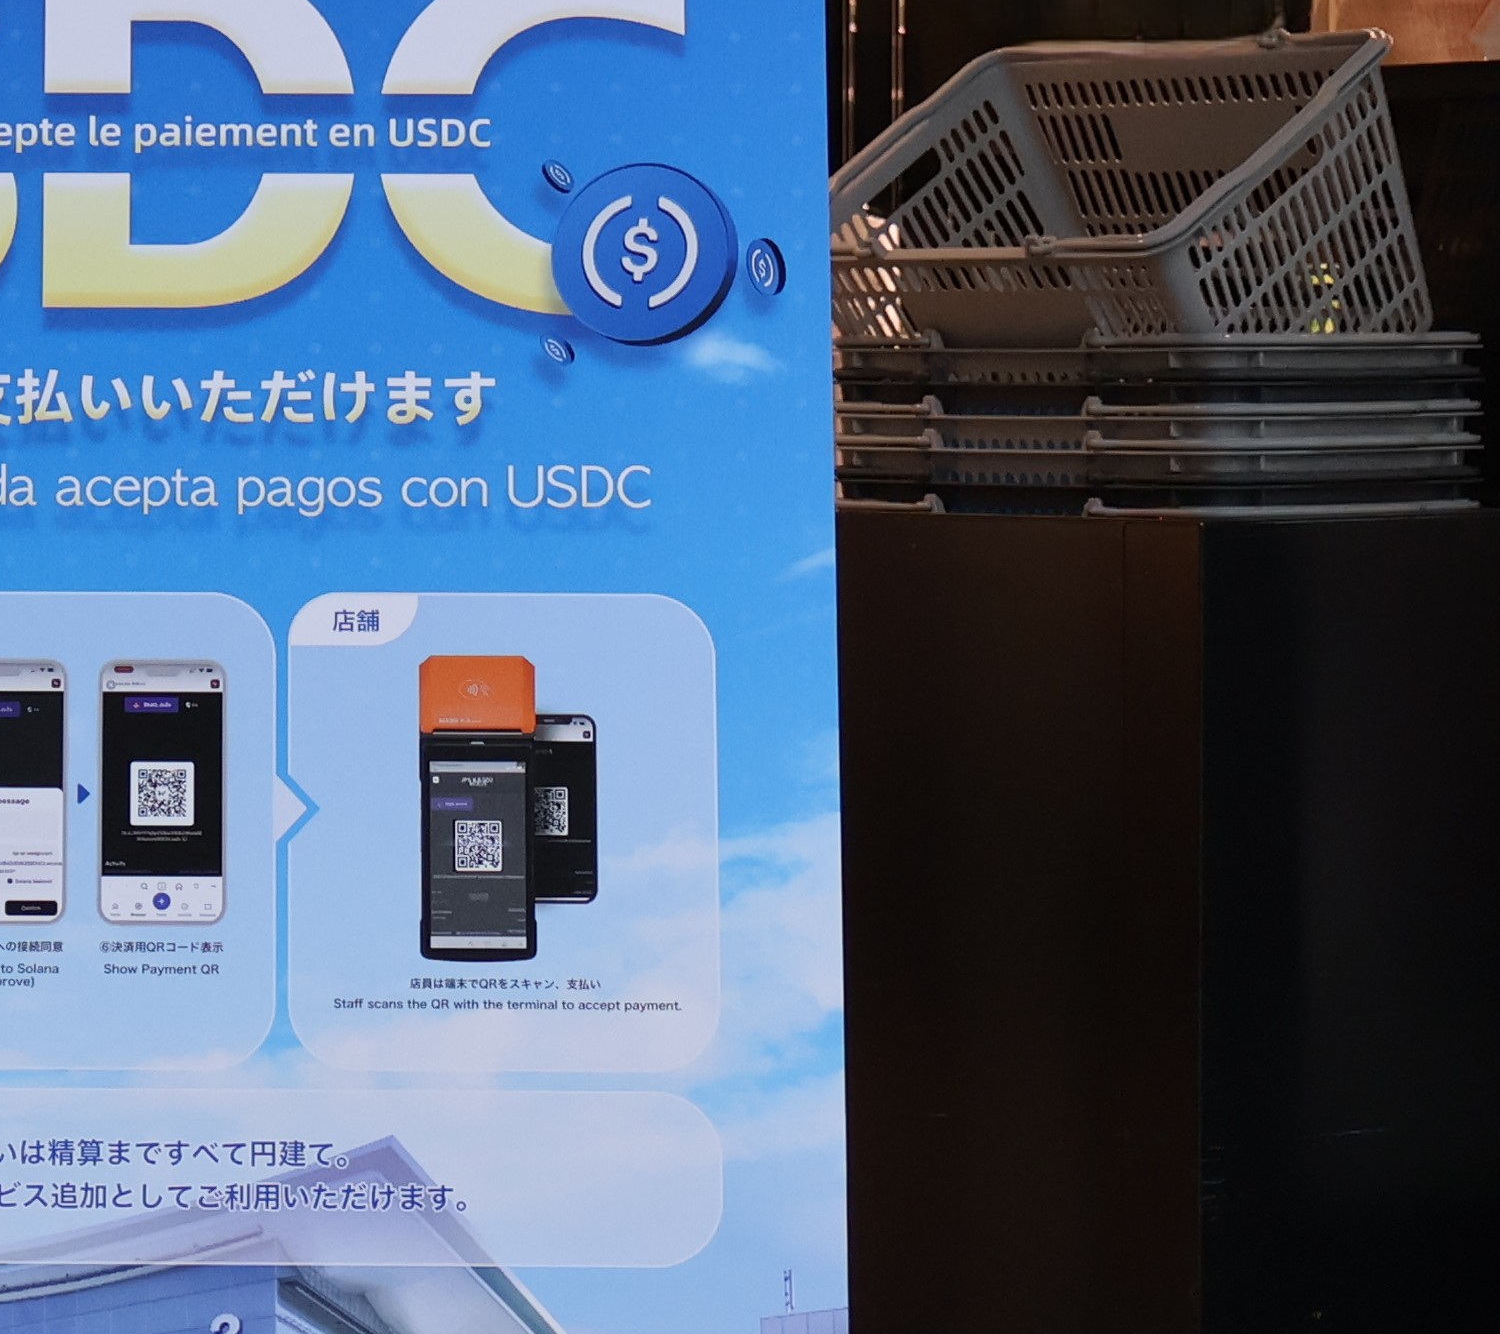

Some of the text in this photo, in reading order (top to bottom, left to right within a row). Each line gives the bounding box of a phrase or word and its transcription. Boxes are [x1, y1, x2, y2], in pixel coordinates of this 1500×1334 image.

[89, 115, 122, 147] le
[134, 115, 318, 154] paiement
[328, 123, 375, 147] en
[389, 118, 491, 148] USDC
[55, 468, 219, 516] acepta
[237, 475, 383, 518] pagos
[401, 476, 488, 508] con
[507, 464, 652, 509] USDC
[331, 609, 381, 635] 店舗
[0, 963, 14, 974] to
[17, 963, 60, 974] Solana
[103, 963, 220, 976] Show Payment QR
[333, 997, 682, 1013] Staff scans the QR with the terminal to accept payment.
